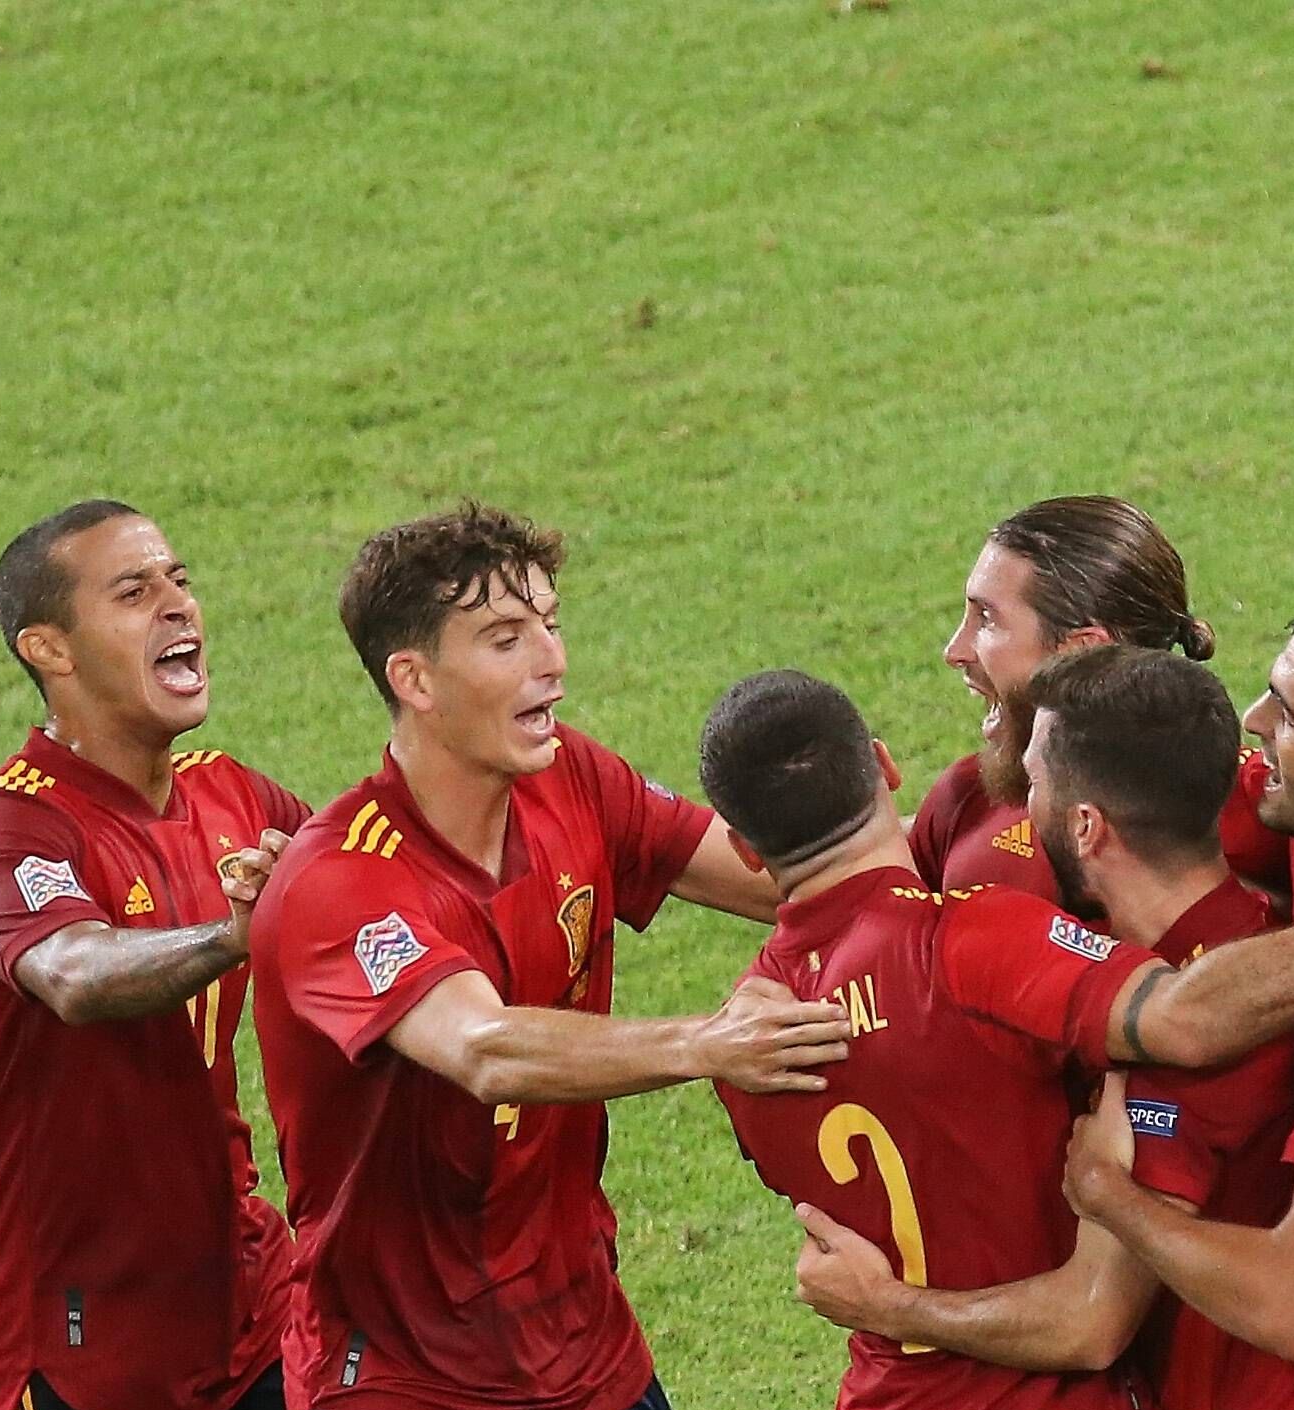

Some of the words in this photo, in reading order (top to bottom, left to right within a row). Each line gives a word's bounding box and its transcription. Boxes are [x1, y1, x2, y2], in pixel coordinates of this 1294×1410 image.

[992, 835, 1036, 859] adidas
[1127, 1108, 1178, 1129] SPECT
[818, 1102, 936, 1354] 2
